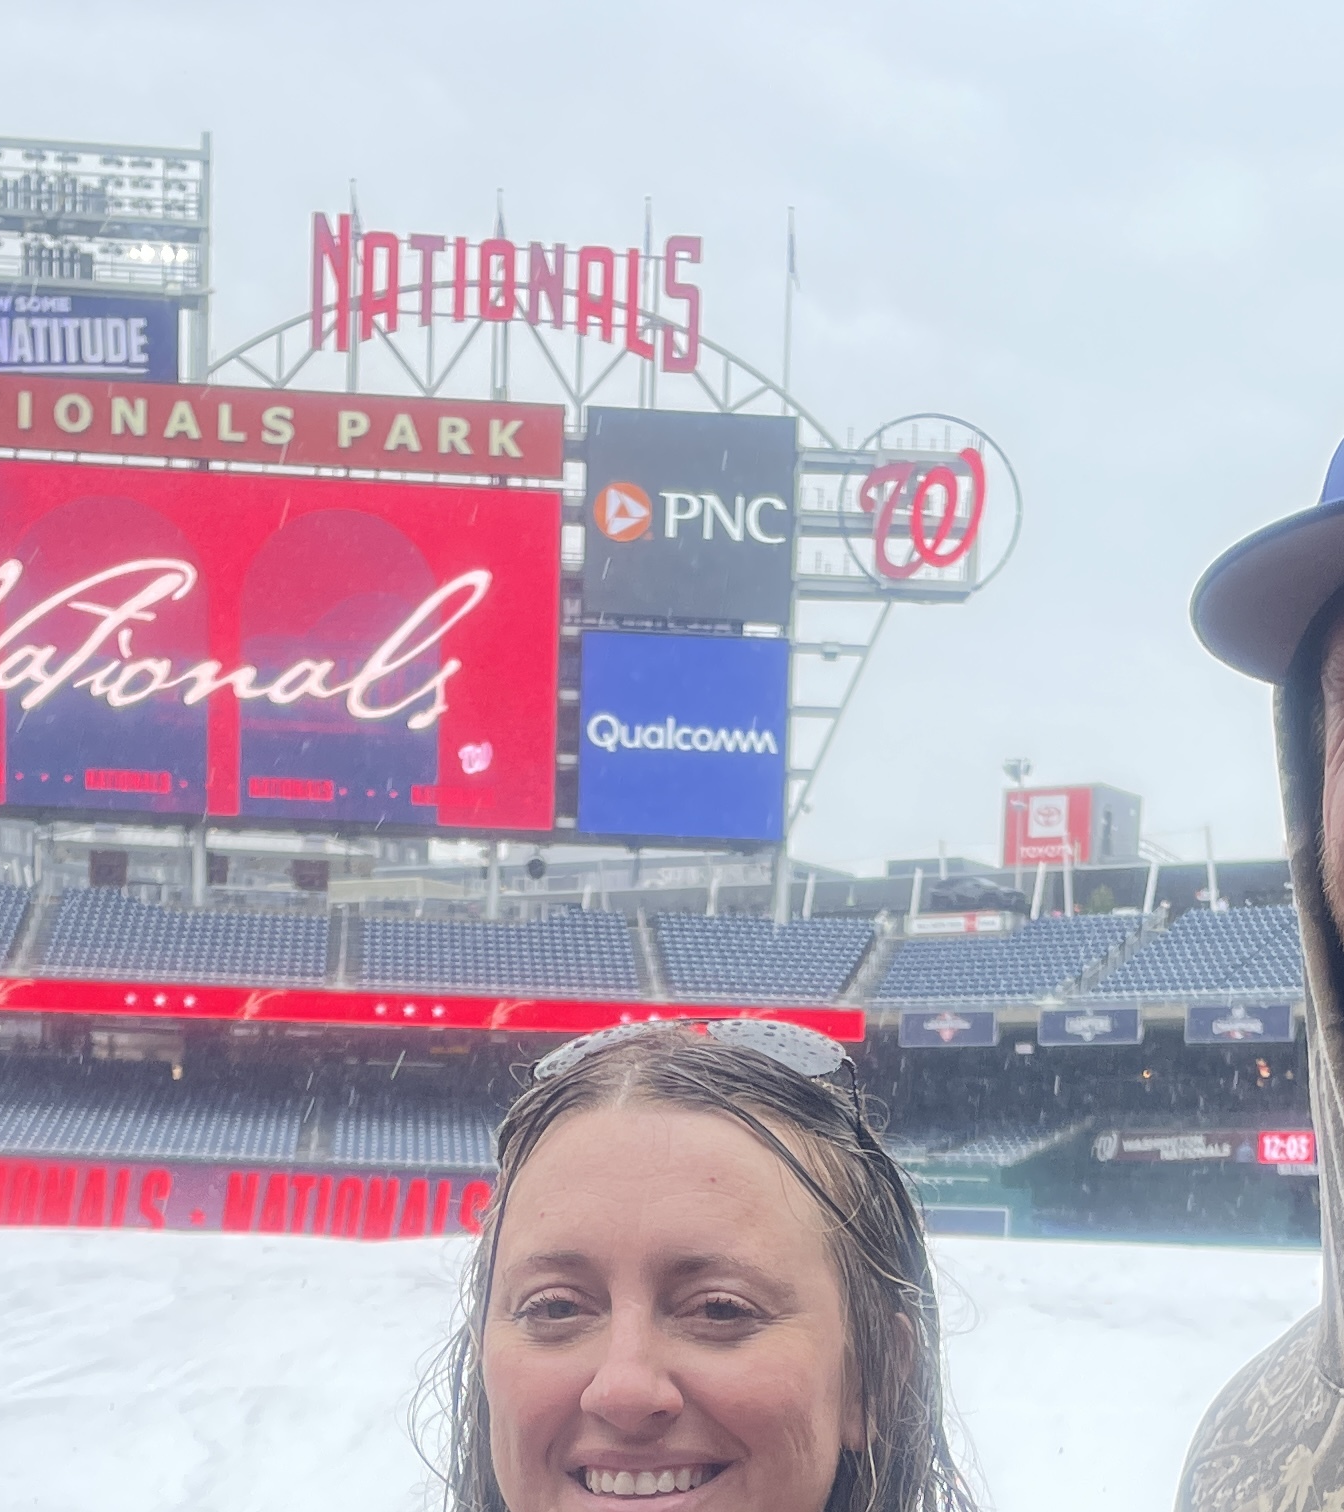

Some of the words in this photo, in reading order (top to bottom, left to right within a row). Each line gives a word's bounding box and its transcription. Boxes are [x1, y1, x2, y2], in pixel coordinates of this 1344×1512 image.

[311, 210, 704, 374] NATIONALS
[337, 409, 525, 460] PARK
[659, 491, 788, 544] PNC
[586, 713, 778, 755] Qualcomm
